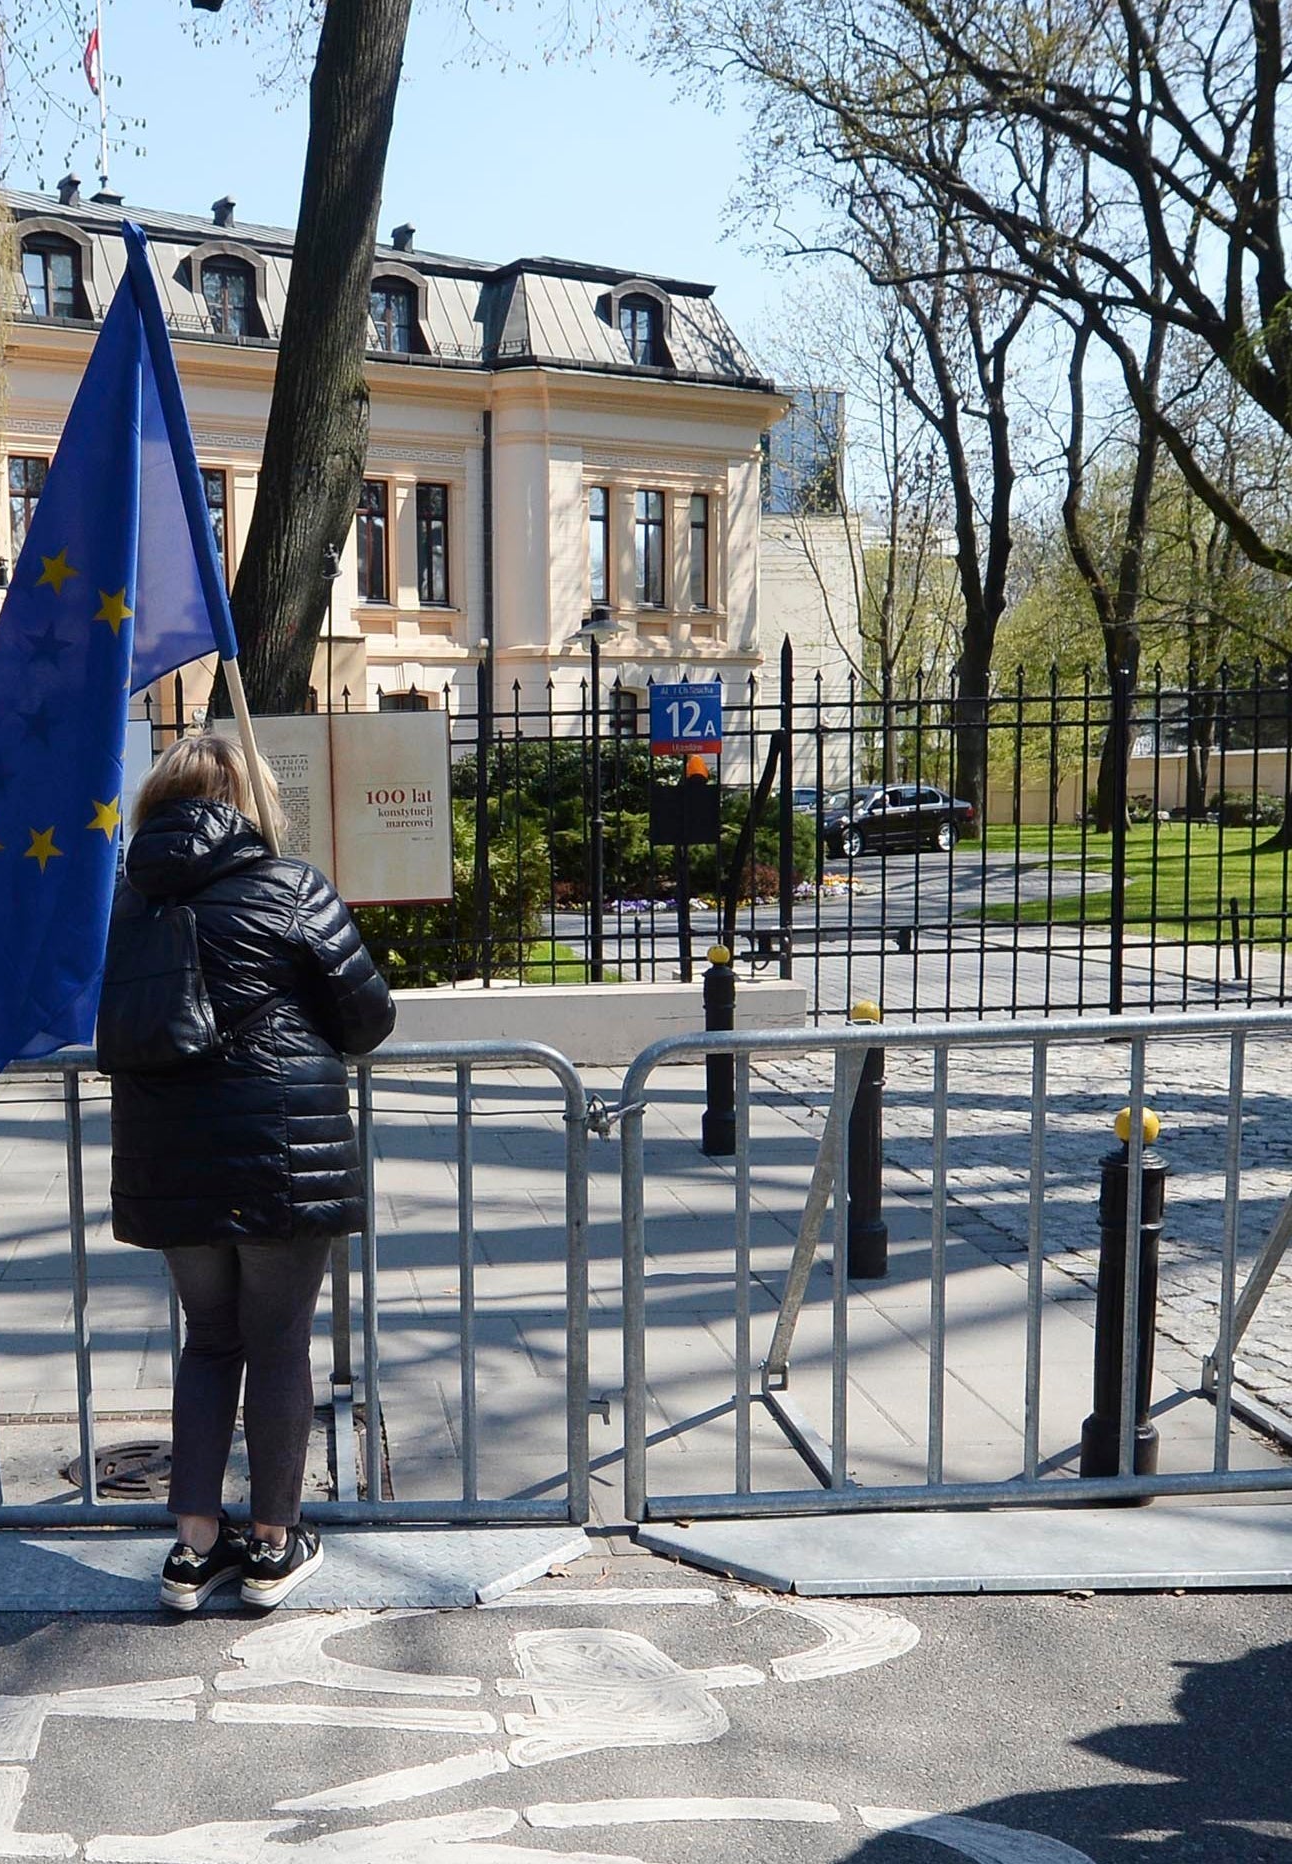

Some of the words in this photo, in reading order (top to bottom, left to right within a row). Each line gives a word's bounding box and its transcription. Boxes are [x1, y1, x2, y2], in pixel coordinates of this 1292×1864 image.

[365, 789, 406, 805] 100
[412, 788, 432, 803] lat
[378, 805, 433, 818] konstytucji
[386, 817, 434, 829] marcowej
